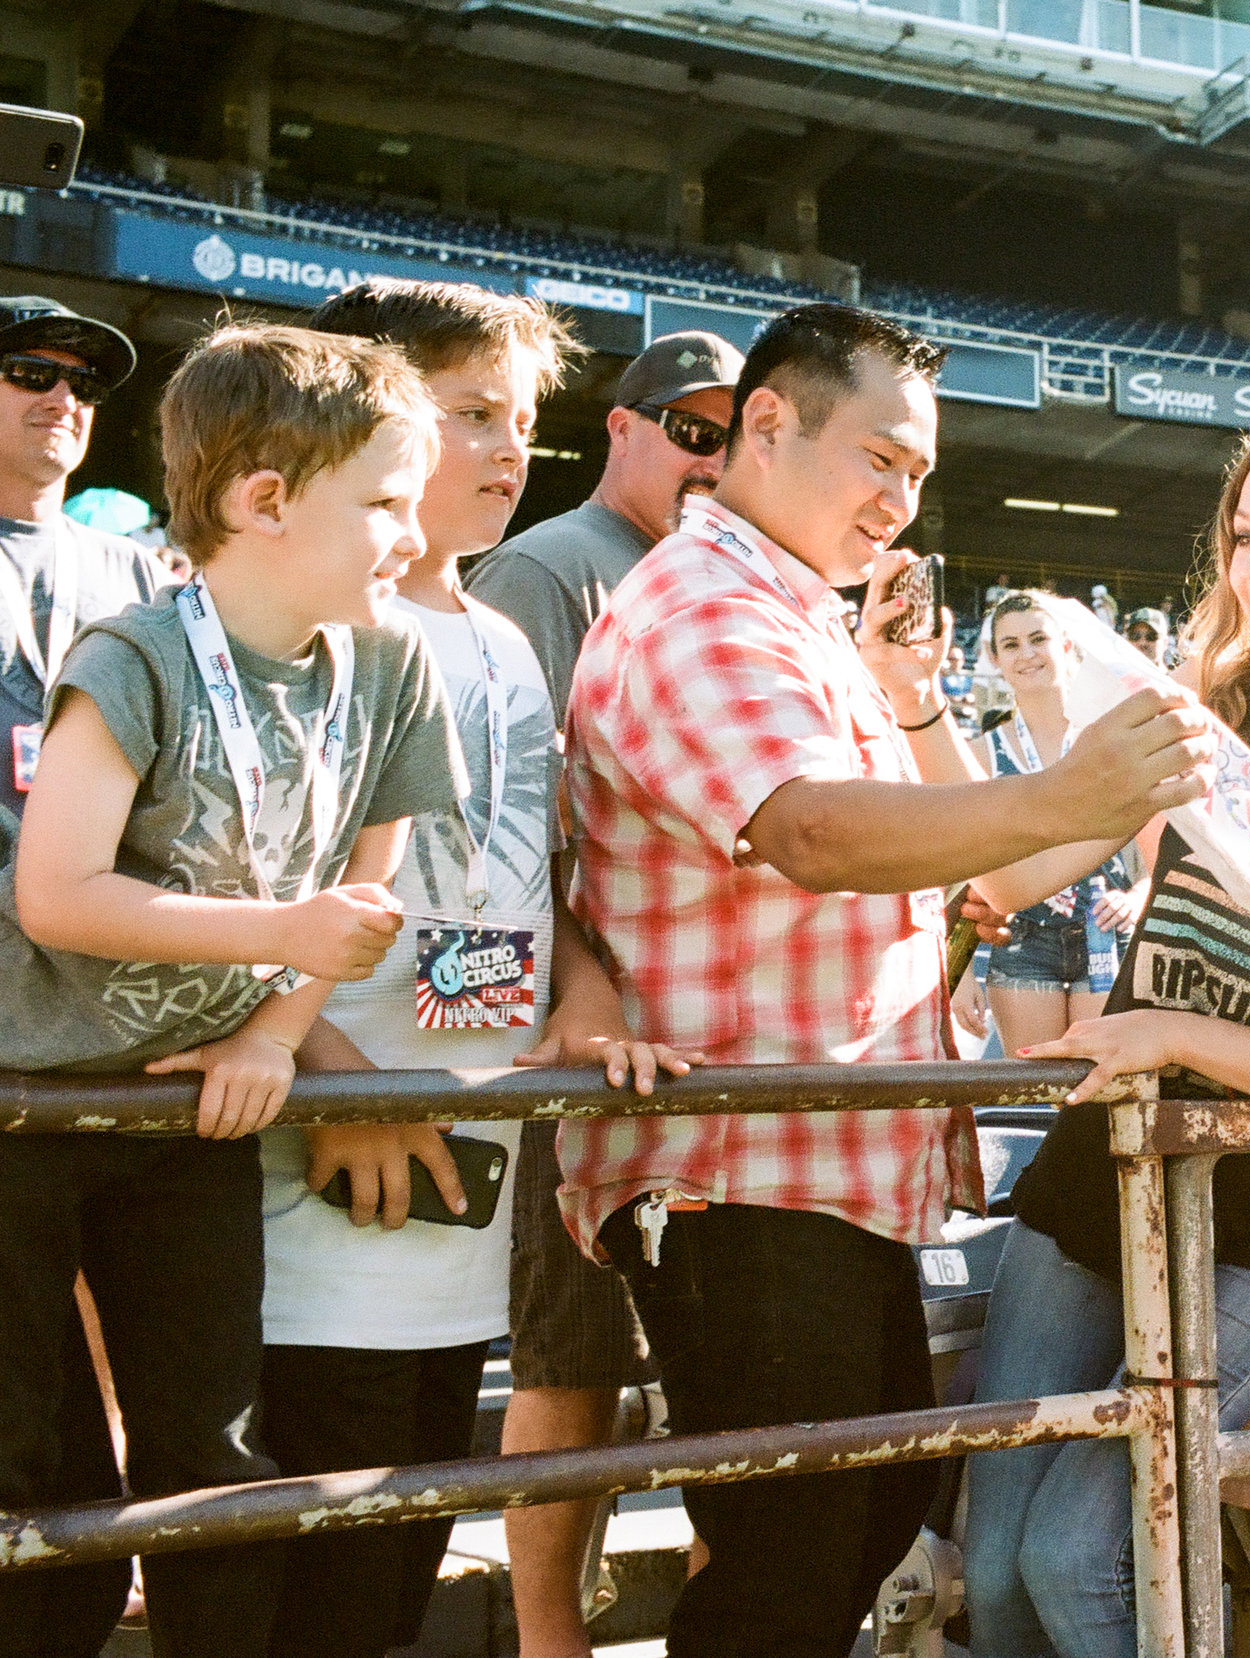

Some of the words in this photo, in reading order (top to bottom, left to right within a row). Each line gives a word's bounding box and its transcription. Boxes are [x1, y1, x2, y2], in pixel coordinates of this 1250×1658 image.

[240, 253, 372, 290] BRIGAN
[460, 945, 516, 971] NITRO
[463, 960, 522, 988] CIRCUS
[482, 987, 521, 1003] LIVE
[931, 1252, 956, 1283] 16
